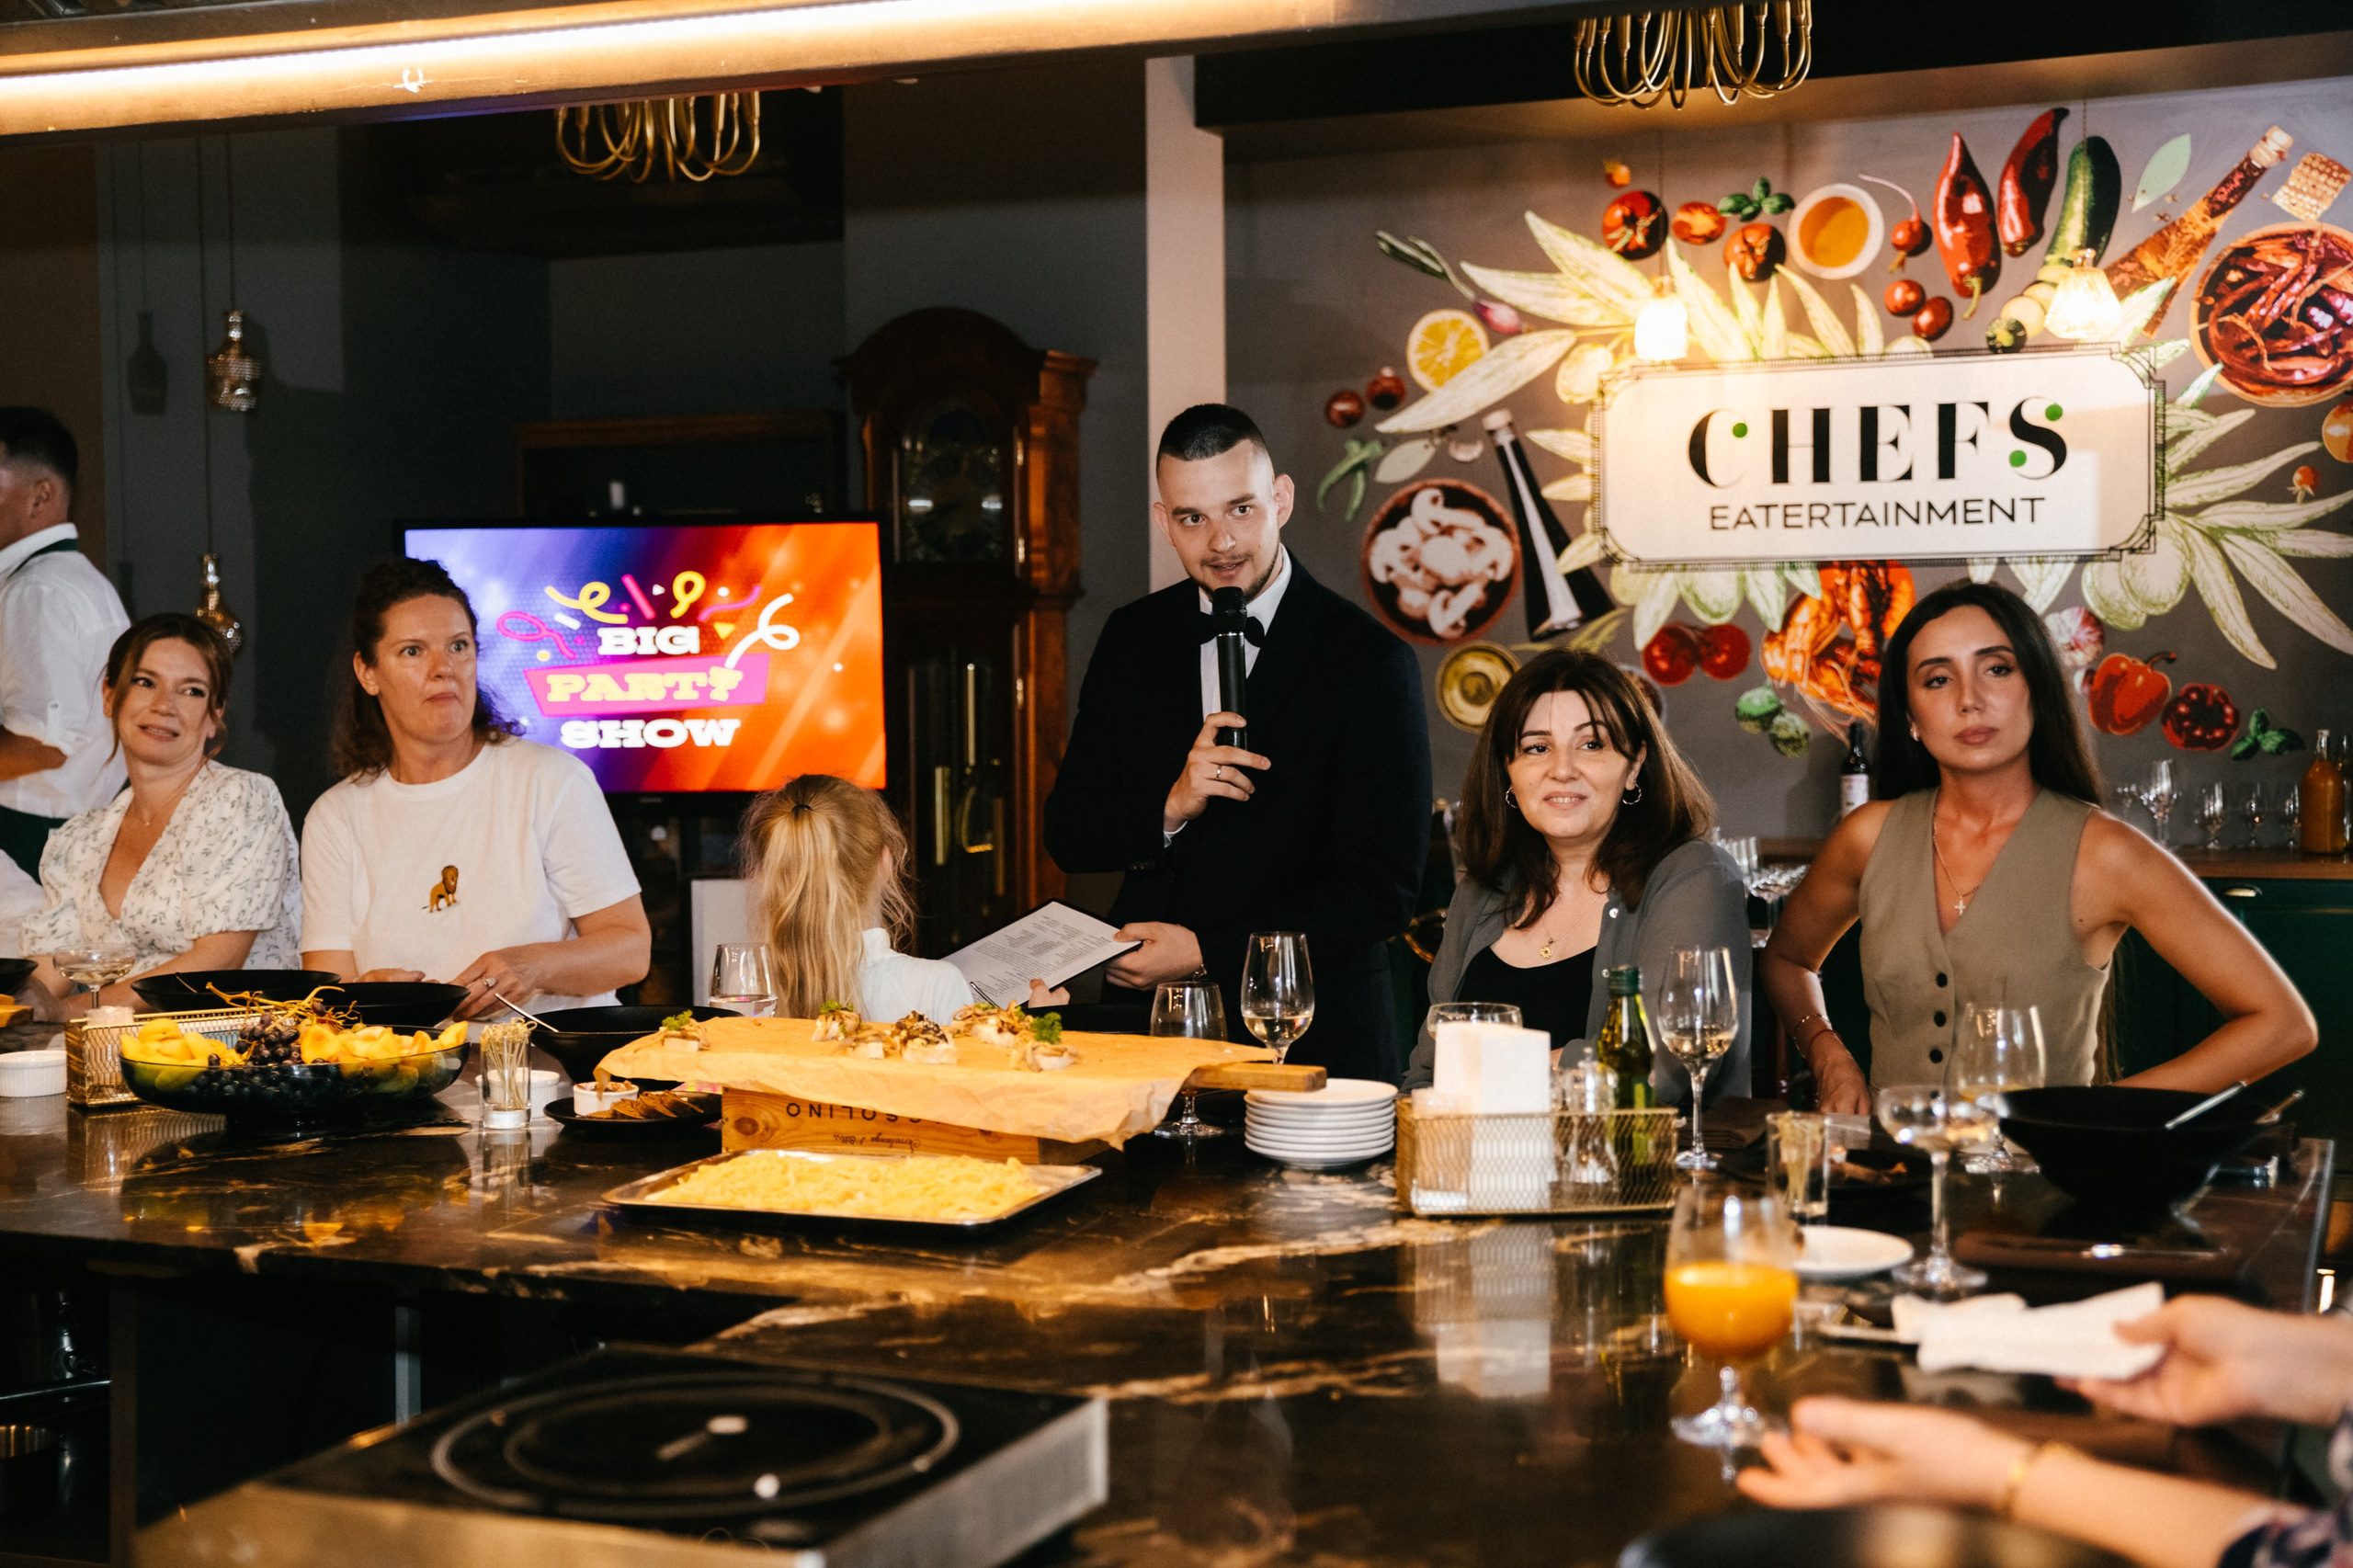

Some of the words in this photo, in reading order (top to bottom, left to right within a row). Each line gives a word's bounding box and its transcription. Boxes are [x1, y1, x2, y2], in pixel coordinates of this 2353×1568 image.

[1688, 396, 2068, 489] CHEFS
[1710, 497, 2046, 530] EATERTAINMENT
[597, 625, 700, 655] BIG
[546, 666, 744, 701] PARTY
[560, 719, 742, 749] SHOW
